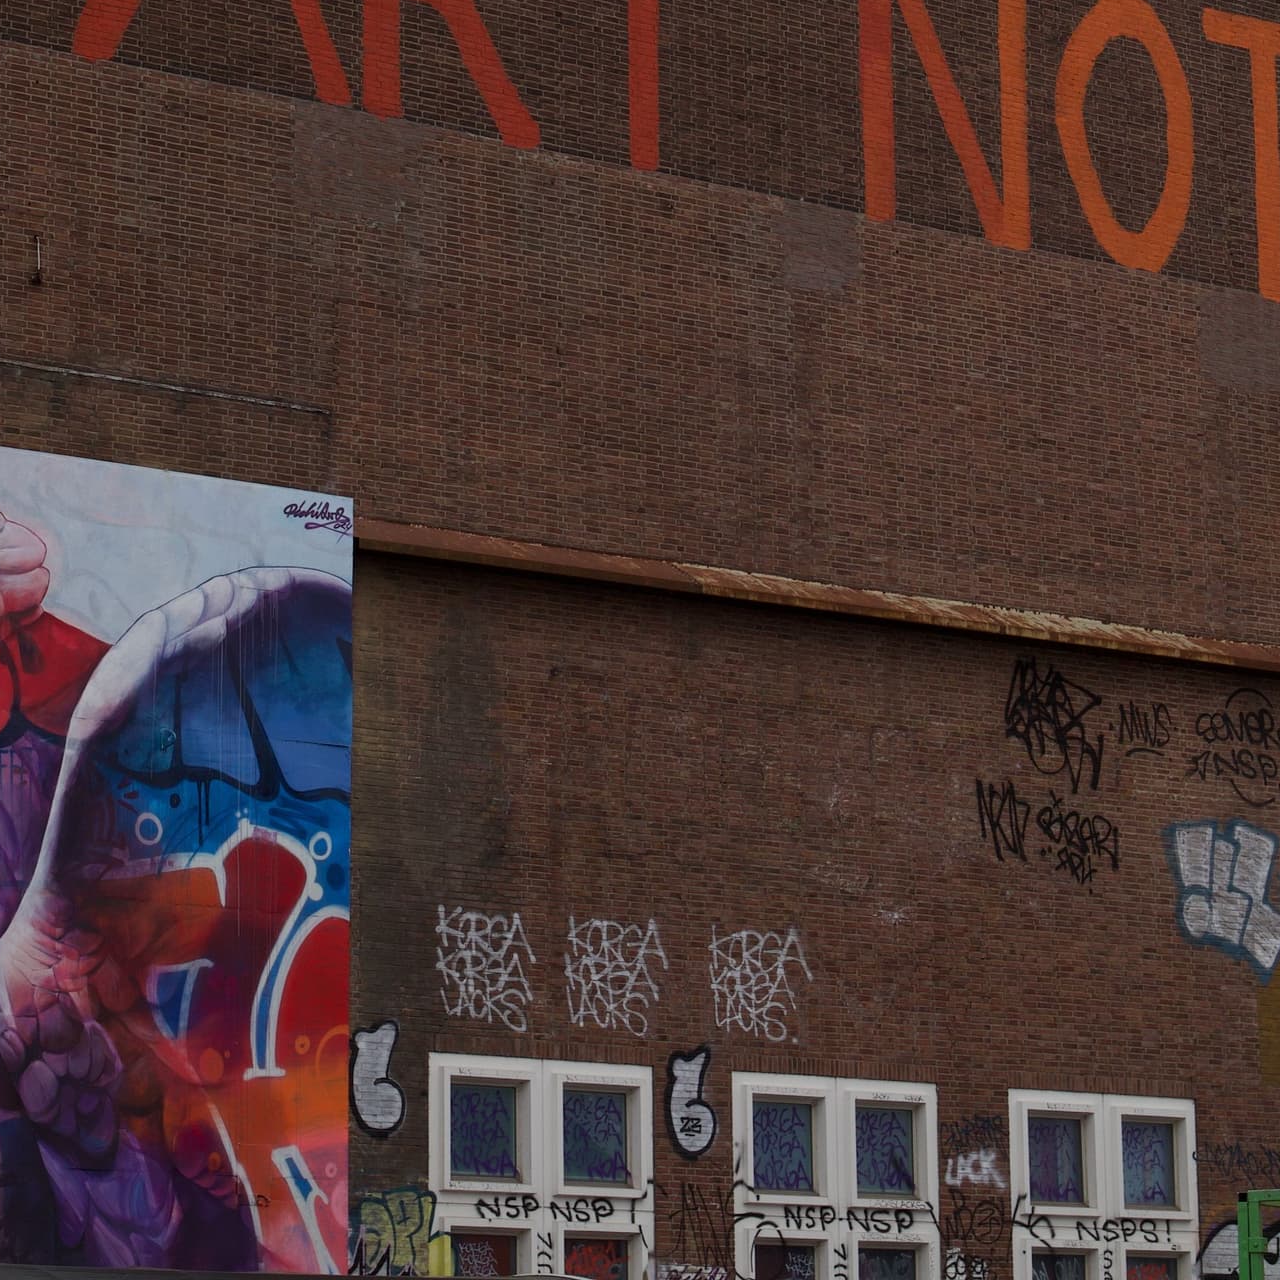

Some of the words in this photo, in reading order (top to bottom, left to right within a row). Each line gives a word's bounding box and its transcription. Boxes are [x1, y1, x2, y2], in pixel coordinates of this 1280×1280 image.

[436, 904, 537, 963] KORGA
[567, 916, 668, 969] KORGA
[708, 924, 813, 982] KORGA
[476, 1195, 540, 1220] NSP
[550, 1197, 614, 1223] NSP
[846, 1209, 914, 1233] NSP
